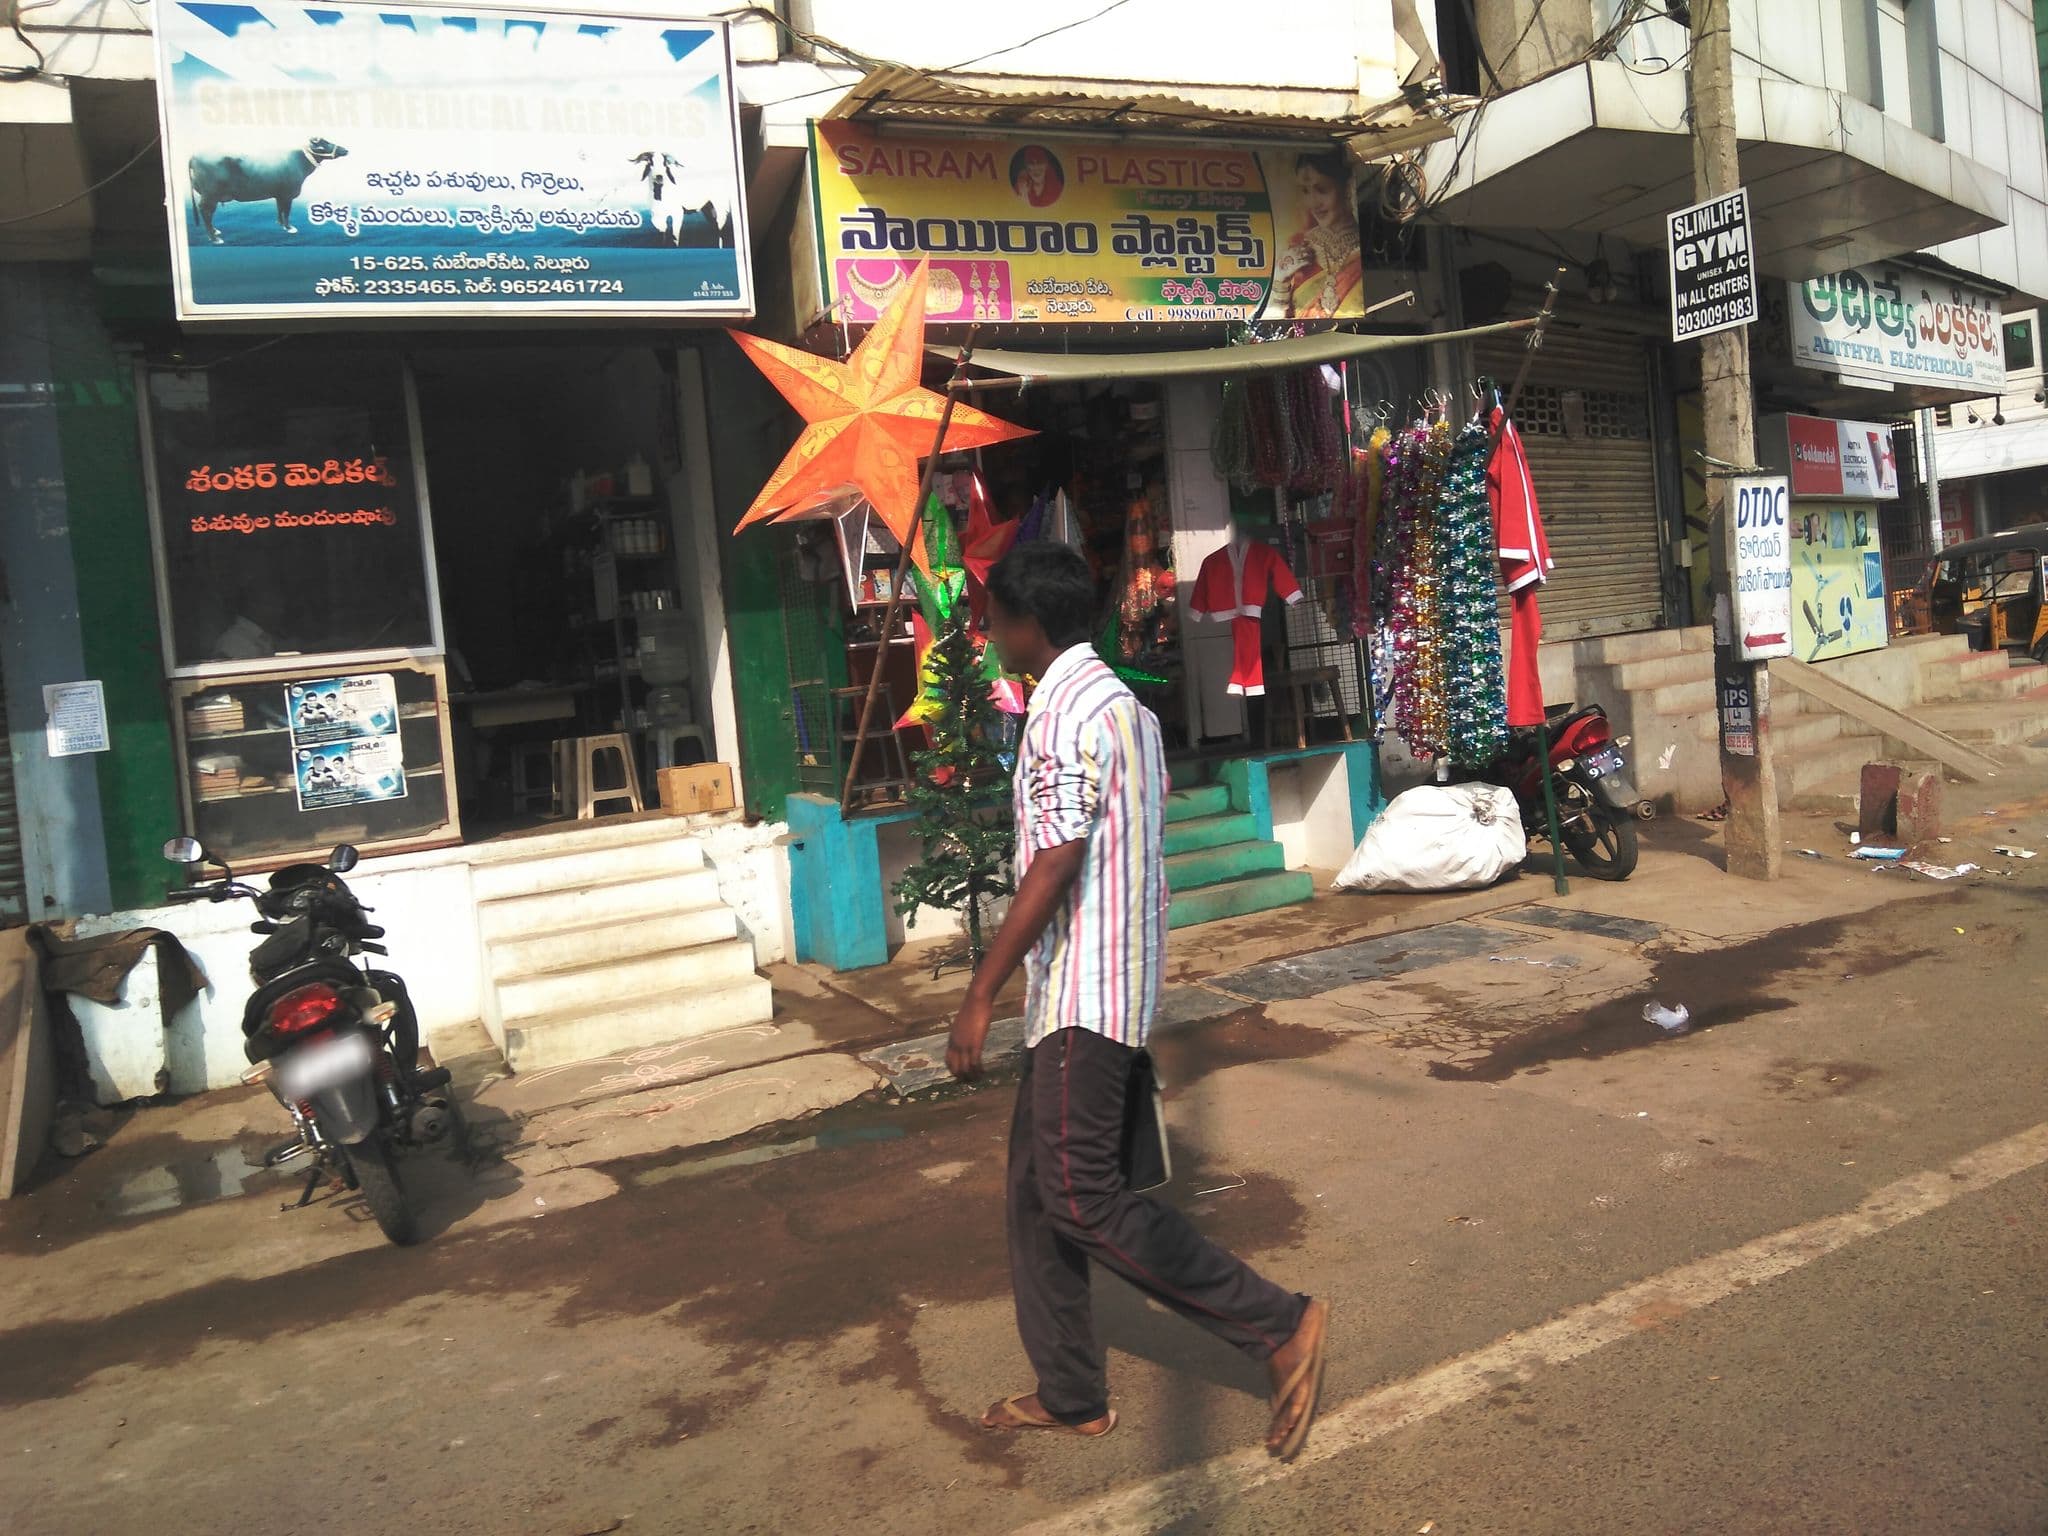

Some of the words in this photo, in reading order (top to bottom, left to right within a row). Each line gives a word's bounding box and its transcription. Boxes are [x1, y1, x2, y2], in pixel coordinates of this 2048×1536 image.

[201, 85, 359, 127] SANKAR
[371, 90, 530, 131] MEDICAL
[839, 145, 997, 180] SAIRAM
[1077, 156, 1245, 188] PLASTICS
[367, 171, 420, 195] ఇచ్చట
[1198, 192, 1246, 210] Shop
[361, 207, 452, 227] మందులు,
[540, 208, 640, 232] అమ్మబడును
[1674, 196, 1743, 241] SLIMLIFE
[840, 208, 1099, 254] సాయిరాం
[1111, 214, 1265, 274] ప్లాస్టిక్స్
[1675, 226, 1746, 271] GYM
[350, 257, 428, 272] 15-625,
[535, 256, 590, 274] నెల్లూరు
[1697, 267, 1723, 281] UNISEX
[1726, 254, 1748, 272] A/C
[365, 280, 461, 296] 2335465,
[501, 280, 624, 295] 9652461724
[1027, 276, 1084, 295] సుబేదారు
[1219, 279, 1263, 301] షాపు
[1678, 292, 1687, 309] IN
[1690, 288, 1706, 306] ALL
[1708, 274, 1749, 300] CENTERS
[1125, 307, 1154, 321] Cell
[1167, 306, 1247, 321] 9989607621
[1678, 296, 1752, 334] 9030091983
[1813, 335, 1884, 366] ADITHYA
[1889, 351, 1973, 379] ELECTRICALS
[184, 463, 278, 493] శంకర్
[1738, 486, 1785, 528] DTDC
[190, 512, 272, 534] పశువుల
[1724, 688, 1748, 706] IPS
